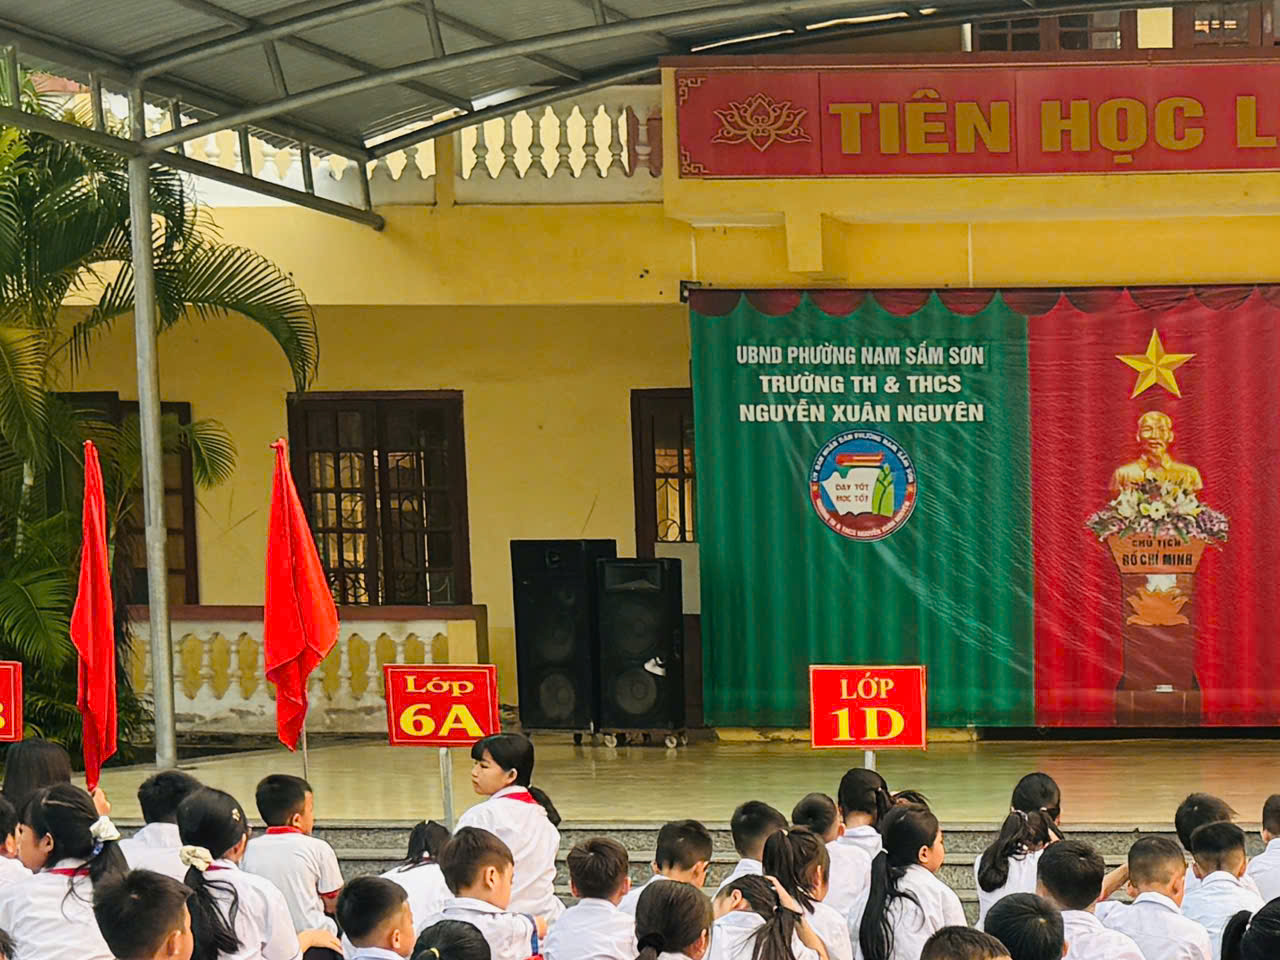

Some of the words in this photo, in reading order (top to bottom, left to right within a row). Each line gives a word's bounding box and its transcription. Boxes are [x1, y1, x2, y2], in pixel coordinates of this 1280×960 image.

[827, 88, 1011, 155] TIÊN
[1041, 94, 1206, 164] HỌC
[737, 345, 783, 365] UBND
[788, 341, 857, 365] PHƯỜNG
[861, 346, 900, 365] NAM
[949, 345, 984, 365] SƠN
[759, 371, 845, 393] TRƯỜNG
[850, 375, 877, 393] TH
[884, 376, 900, 393] &
[906, 375, 962, 393] THCS
[739, 398, 826, 422] NGUYỄN
[832, 401, 891, 422] XUÂN
[897, 401, 984, 422] NGUYÊN
[404, 675, 475, 697] Lớp
[840, 672, 895, 699] LỚP
[400, 703, 486, 737] 6A
[829, 707, 905, 741] 1D
